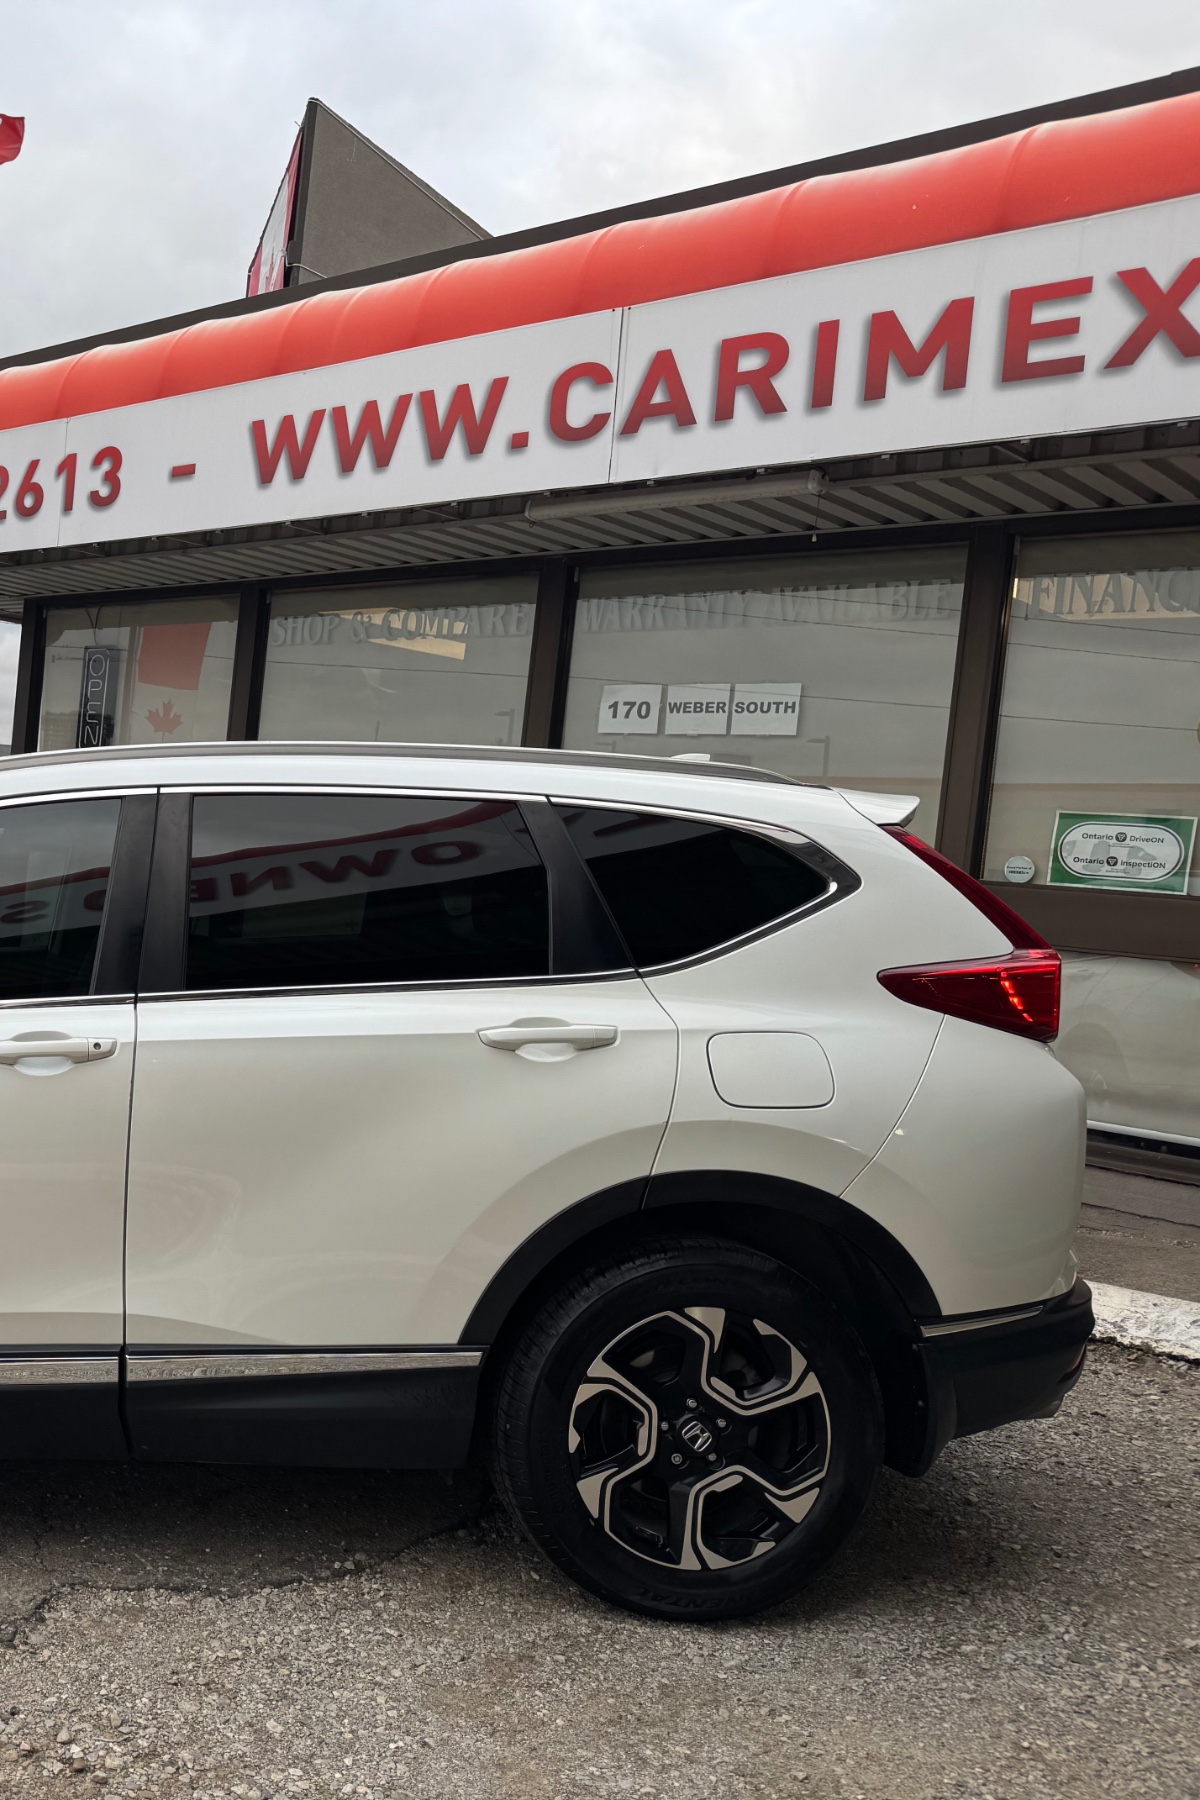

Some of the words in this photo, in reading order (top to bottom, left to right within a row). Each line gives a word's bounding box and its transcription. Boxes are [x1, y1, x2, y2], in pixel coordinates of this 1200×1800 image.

[251, 257, 1200, 486] WWW.CARIMEX
[270, 611, 340, 647] SHOP
[351, 611, 373, 642] &
[381, 603, 530, 641] COMPARE
[84, 654, 106, 745] OPEN
[607, 700, 652, 720] 170
[668, 701, 727, 714] WEBER
[734, 701, 797, 714] SOUTH
[1081, 832, 1114, 841] Ontario
[1129, 835, 1165, 844] DriveON
[1073, 856, 1105, 865] Ontario
